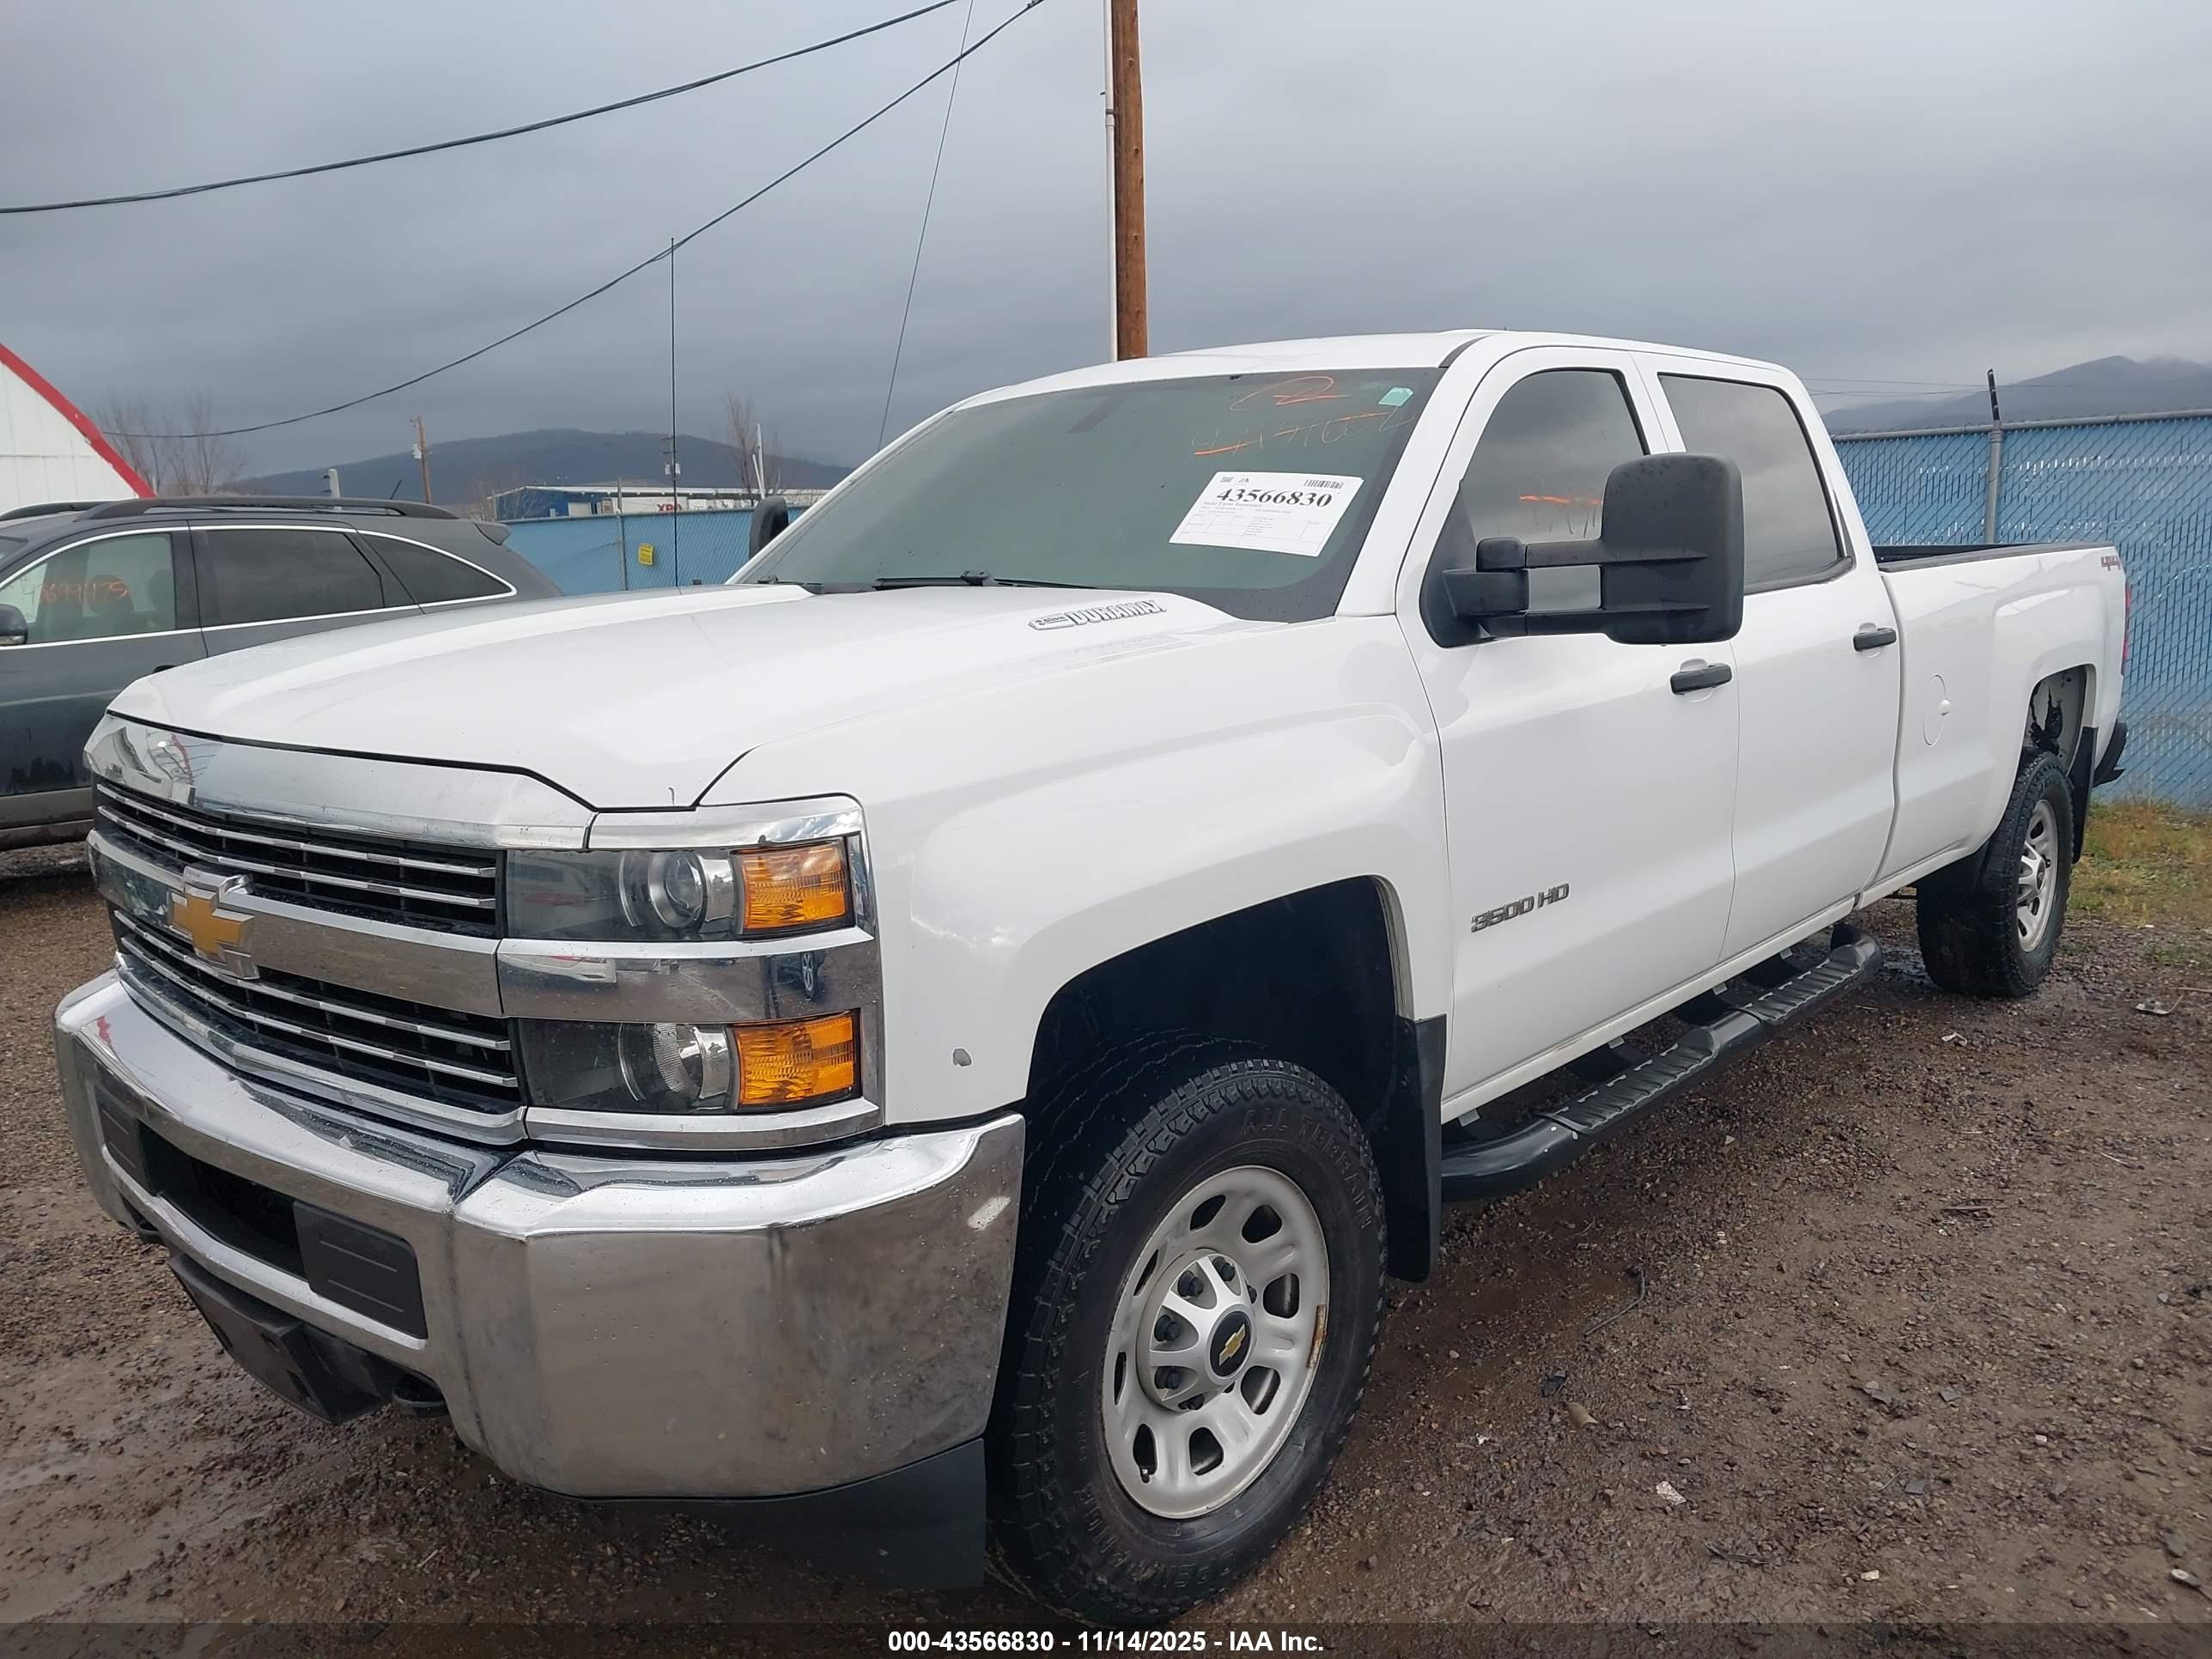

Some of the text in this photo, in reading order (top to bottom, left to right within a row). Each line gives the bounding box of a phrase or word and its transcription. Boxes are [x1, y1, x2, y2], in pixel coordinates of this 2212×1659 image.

[1216, 487, 1333, 508] 43566830
[1063, 599, 1168, 626] DURAMAX
[1470, 883, 1571, 933] 3500 HD
